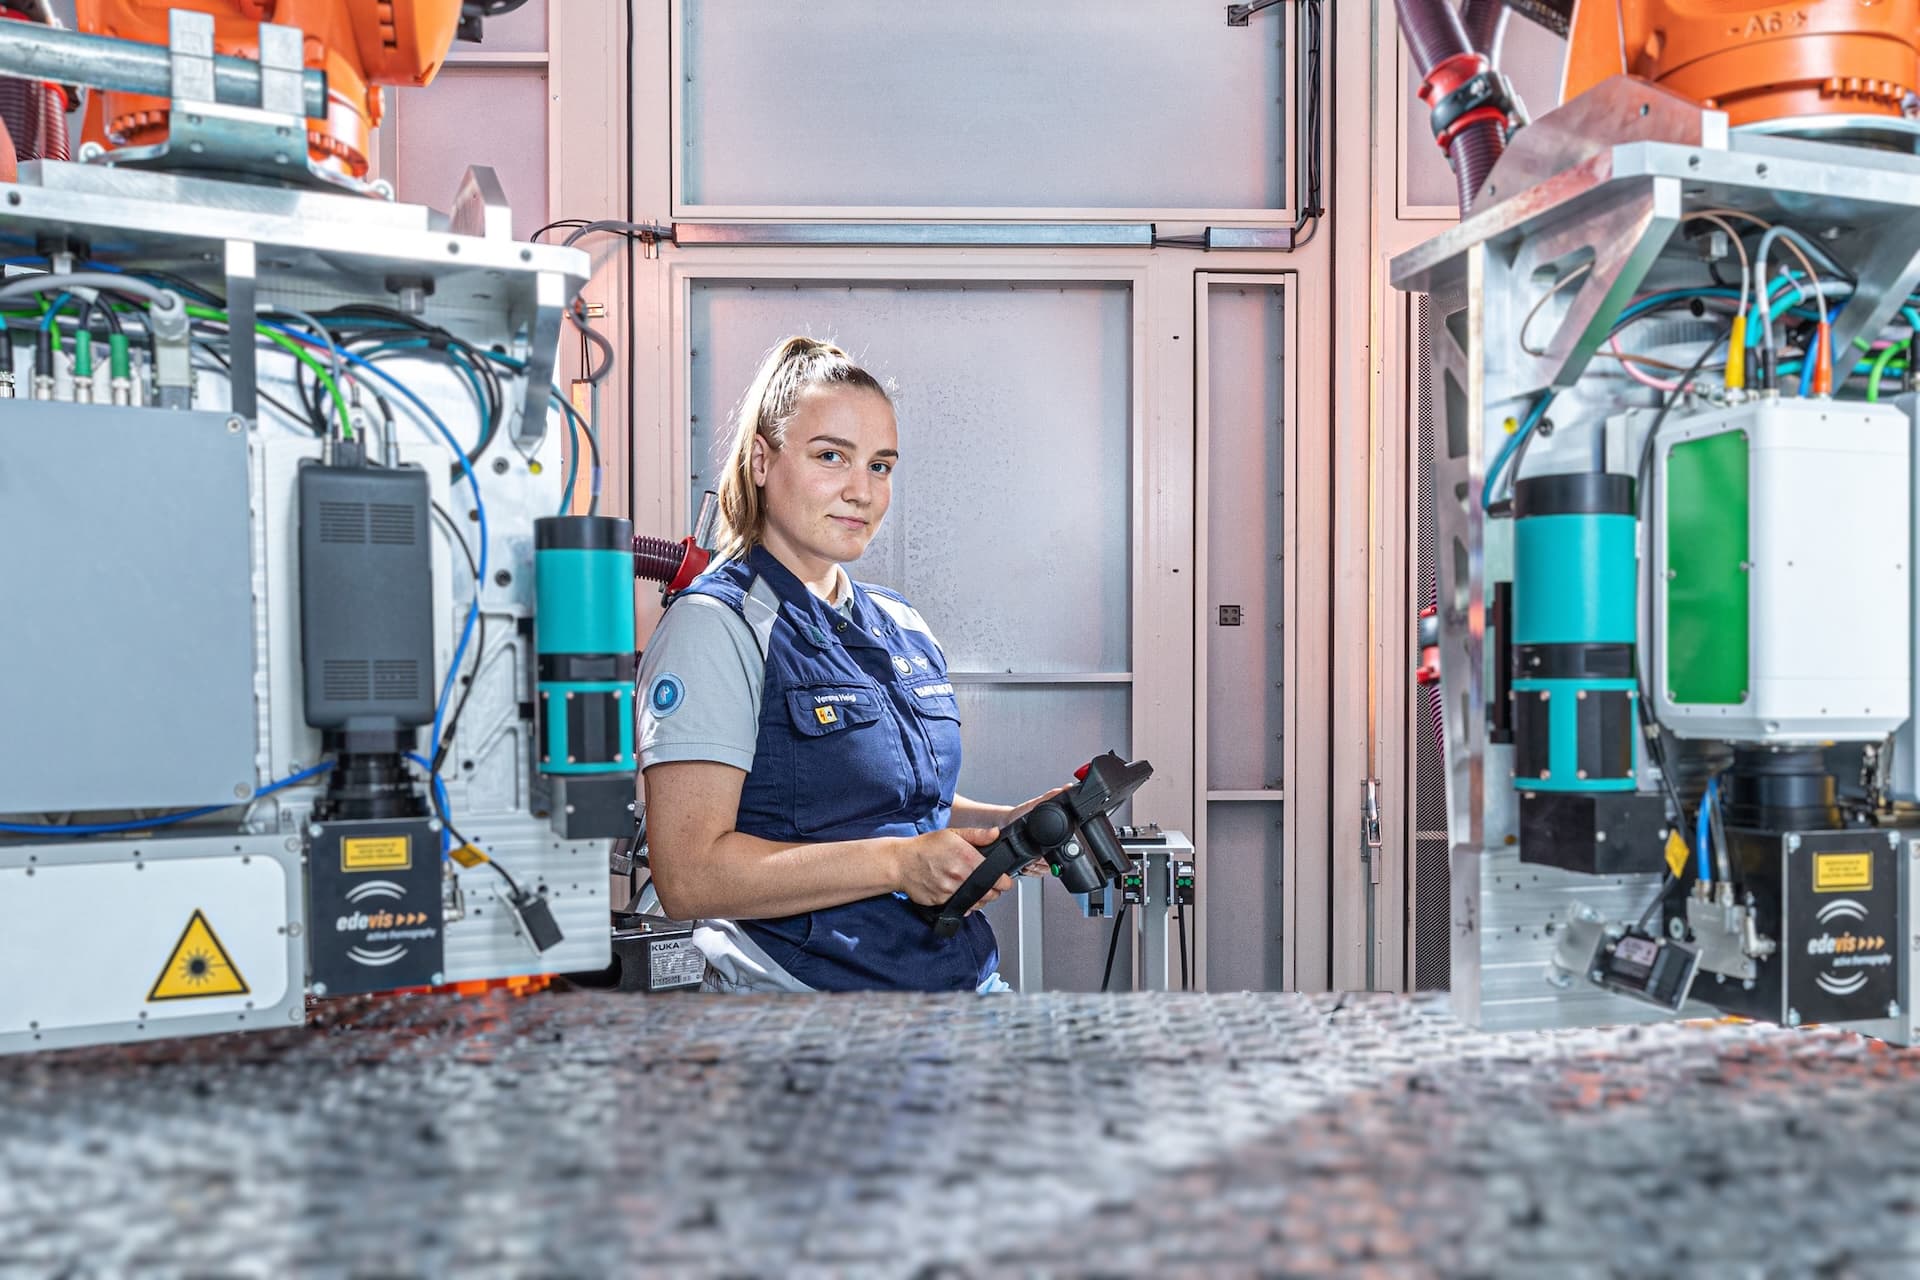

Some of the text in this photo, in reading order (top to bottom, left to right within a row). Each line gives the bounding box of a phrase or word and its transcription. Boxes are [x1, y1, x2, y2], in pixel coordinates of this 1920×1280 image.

[336, 909, 393, 931] edevis
[651, 942, 680, 951] KUKA
[1807, 931, 1856, 955] edevis
